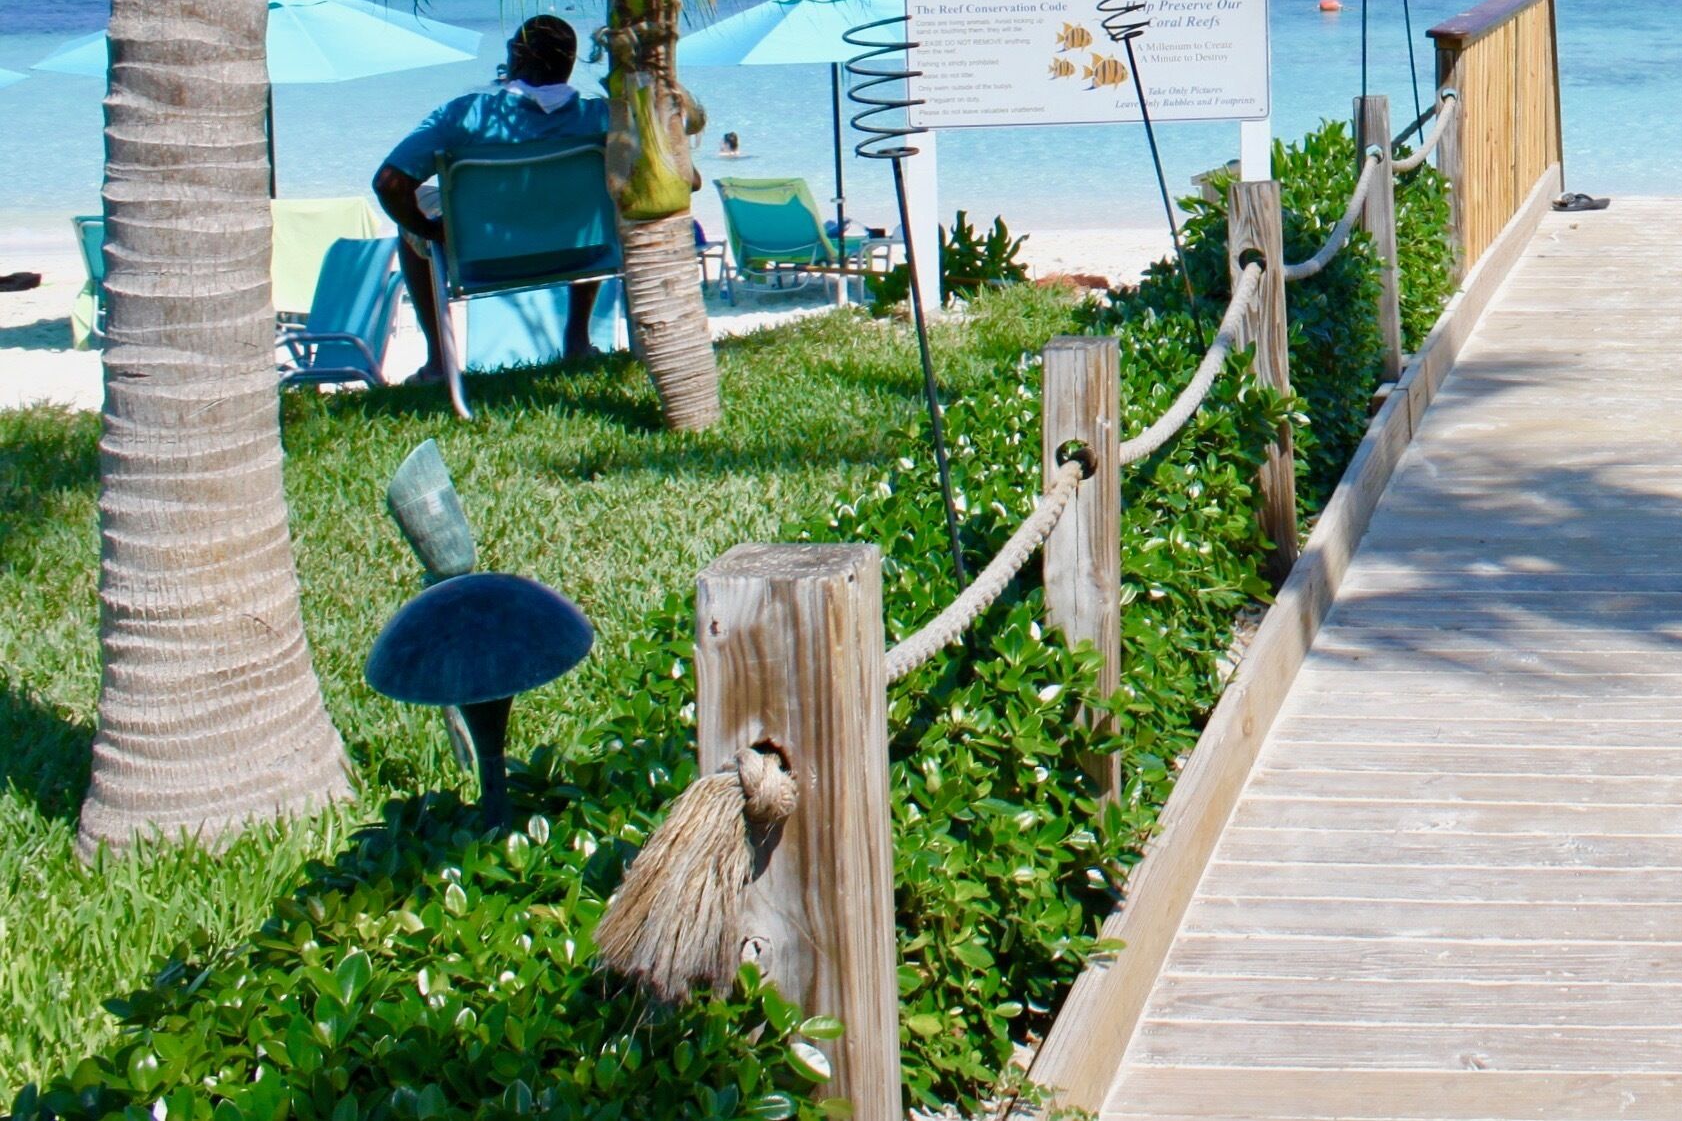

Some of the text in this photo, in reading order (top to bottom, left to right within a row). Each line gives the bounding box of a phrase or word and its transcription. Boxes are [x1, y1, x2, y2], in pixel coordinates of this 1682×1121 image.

[915, 2, 1068, 15] The Reef Conservation Code
[1159, 0, 1215, 12] Preserve
[1148, 15, 1221, 29] Coral Reefs
[1136, 44, 1144, 52] A
[1193, 41, 1203, 50] to
[1204, 41, 1233, 50] Create
[1140, 52, 1229, 64] A Minute to Destroy
[1141, 98, 1160, 109] nly
